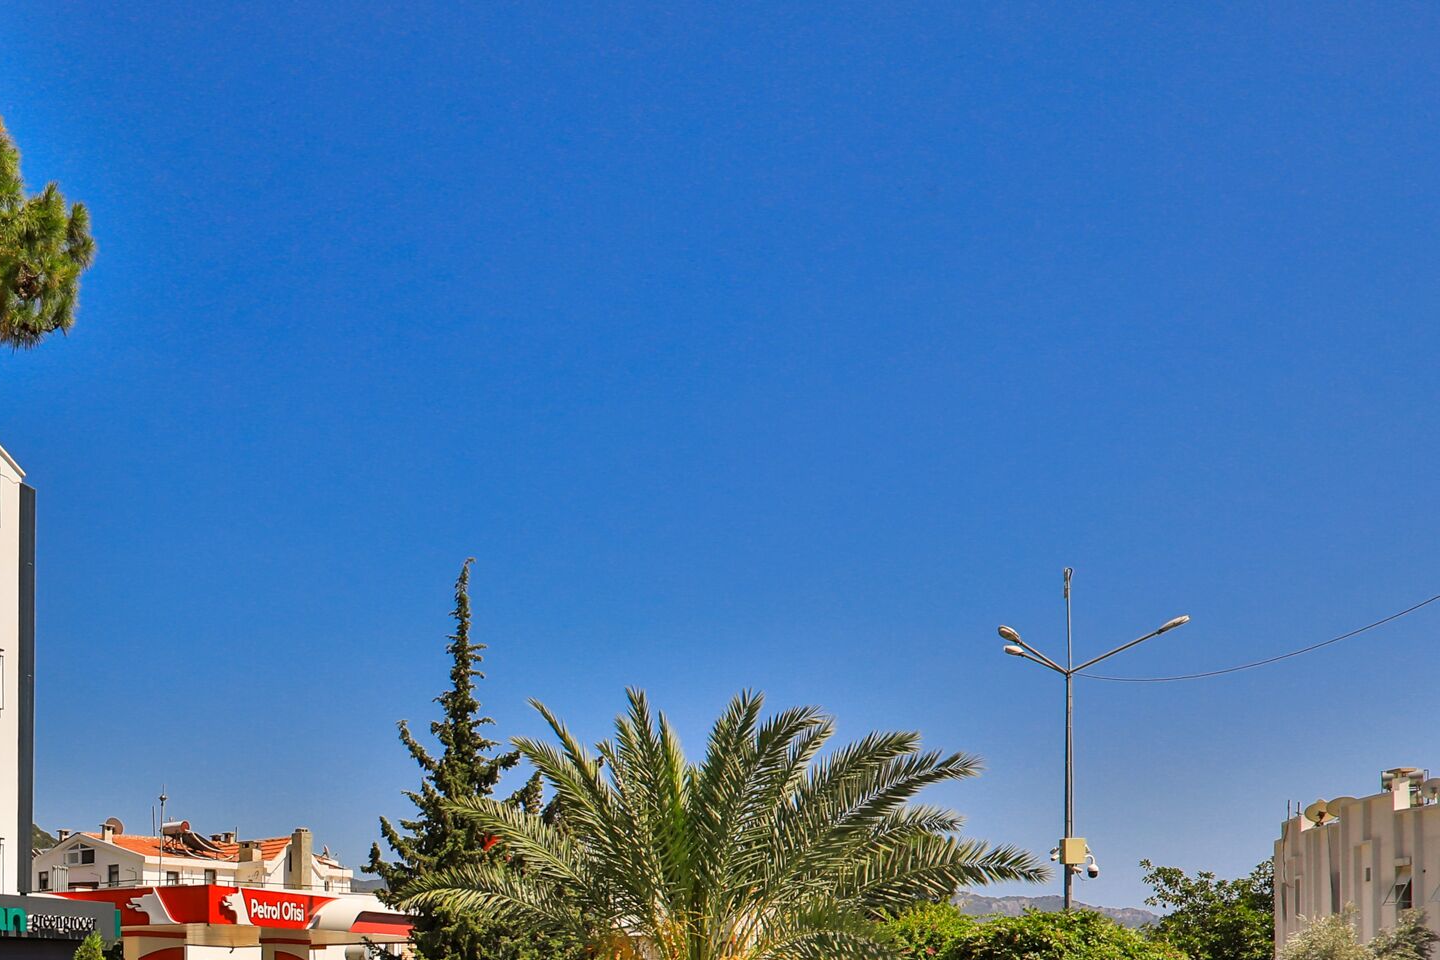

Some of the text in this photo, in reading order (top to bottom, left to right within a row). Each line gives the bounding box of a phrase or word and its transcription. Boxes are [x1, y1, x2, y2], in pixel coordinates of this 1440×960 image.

[251, 898, 304, 922] Petrol Ofisi
[31, 913, 97, 933] greengrocer
